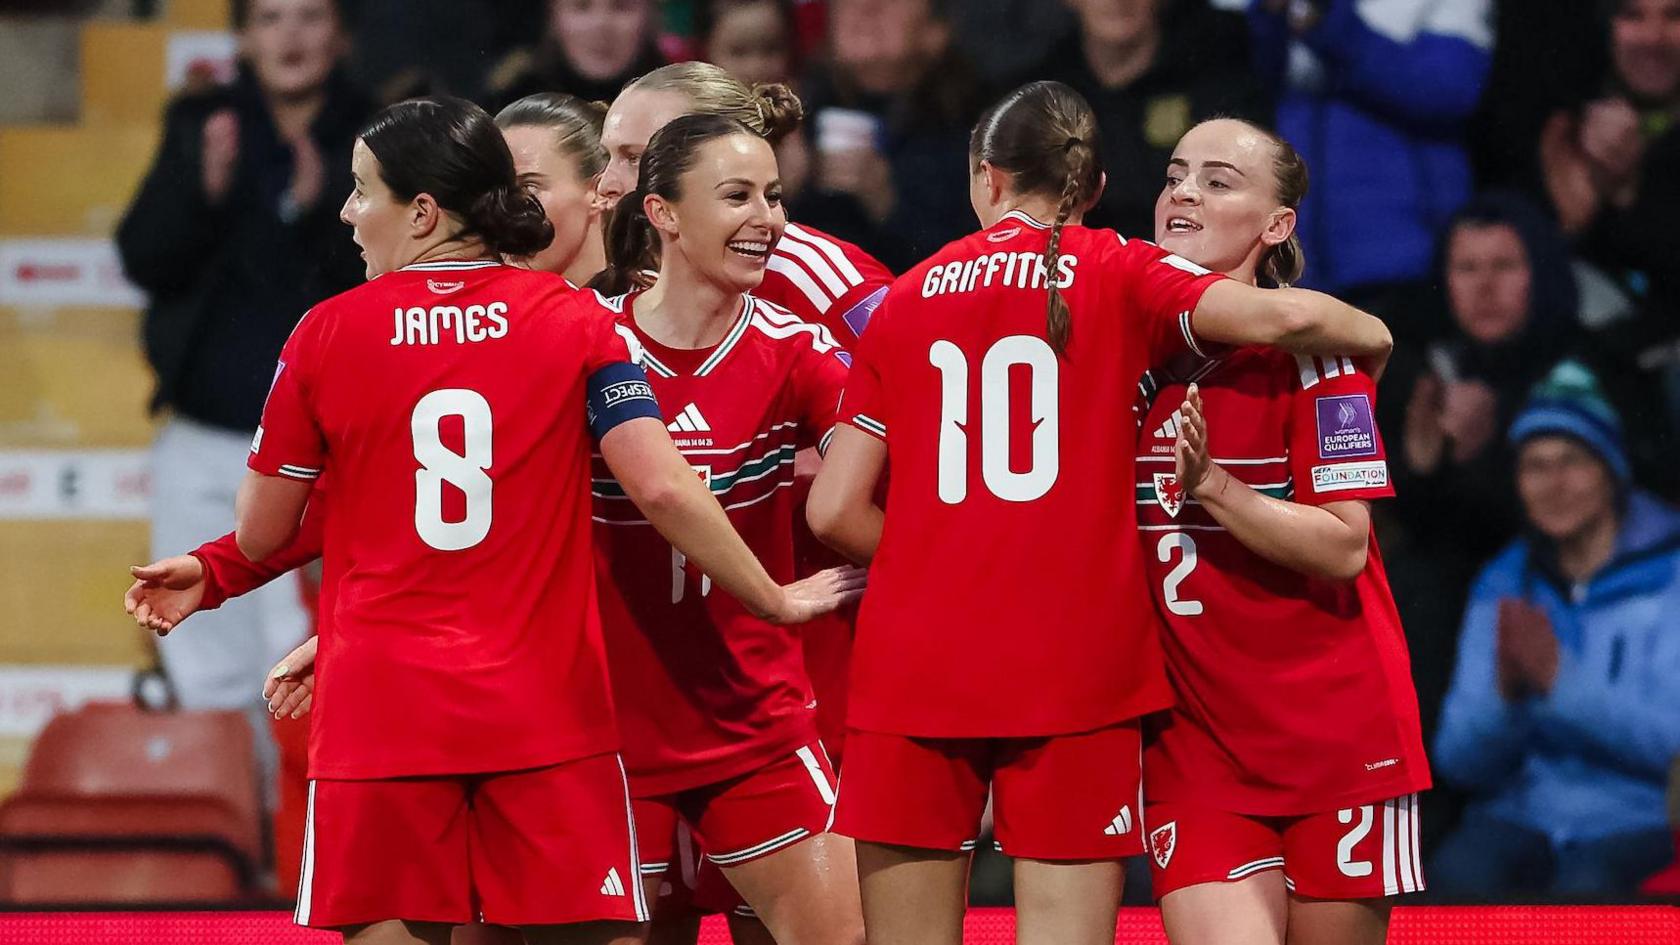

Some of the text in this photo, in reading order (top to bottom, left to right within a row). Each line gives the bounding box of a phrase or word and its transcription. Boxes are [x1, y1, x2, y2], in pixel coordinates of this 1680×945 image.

[921, 251, 1078, 298] GRIFFITHS
[390, 301, 509, 346] JAMES
[929, 334, 1059, 504] 10
[1324, 432, 1370, 444] EUROPEAN
[411, 388, 493, 551] 8
[1323, 440, 1372, 452] QUALIFIERS
[1314, 469, 1385, 482] FOUNDATION
[1157, 532, 1204, 616] 2
[1337, 805, 1374, 877] 2
